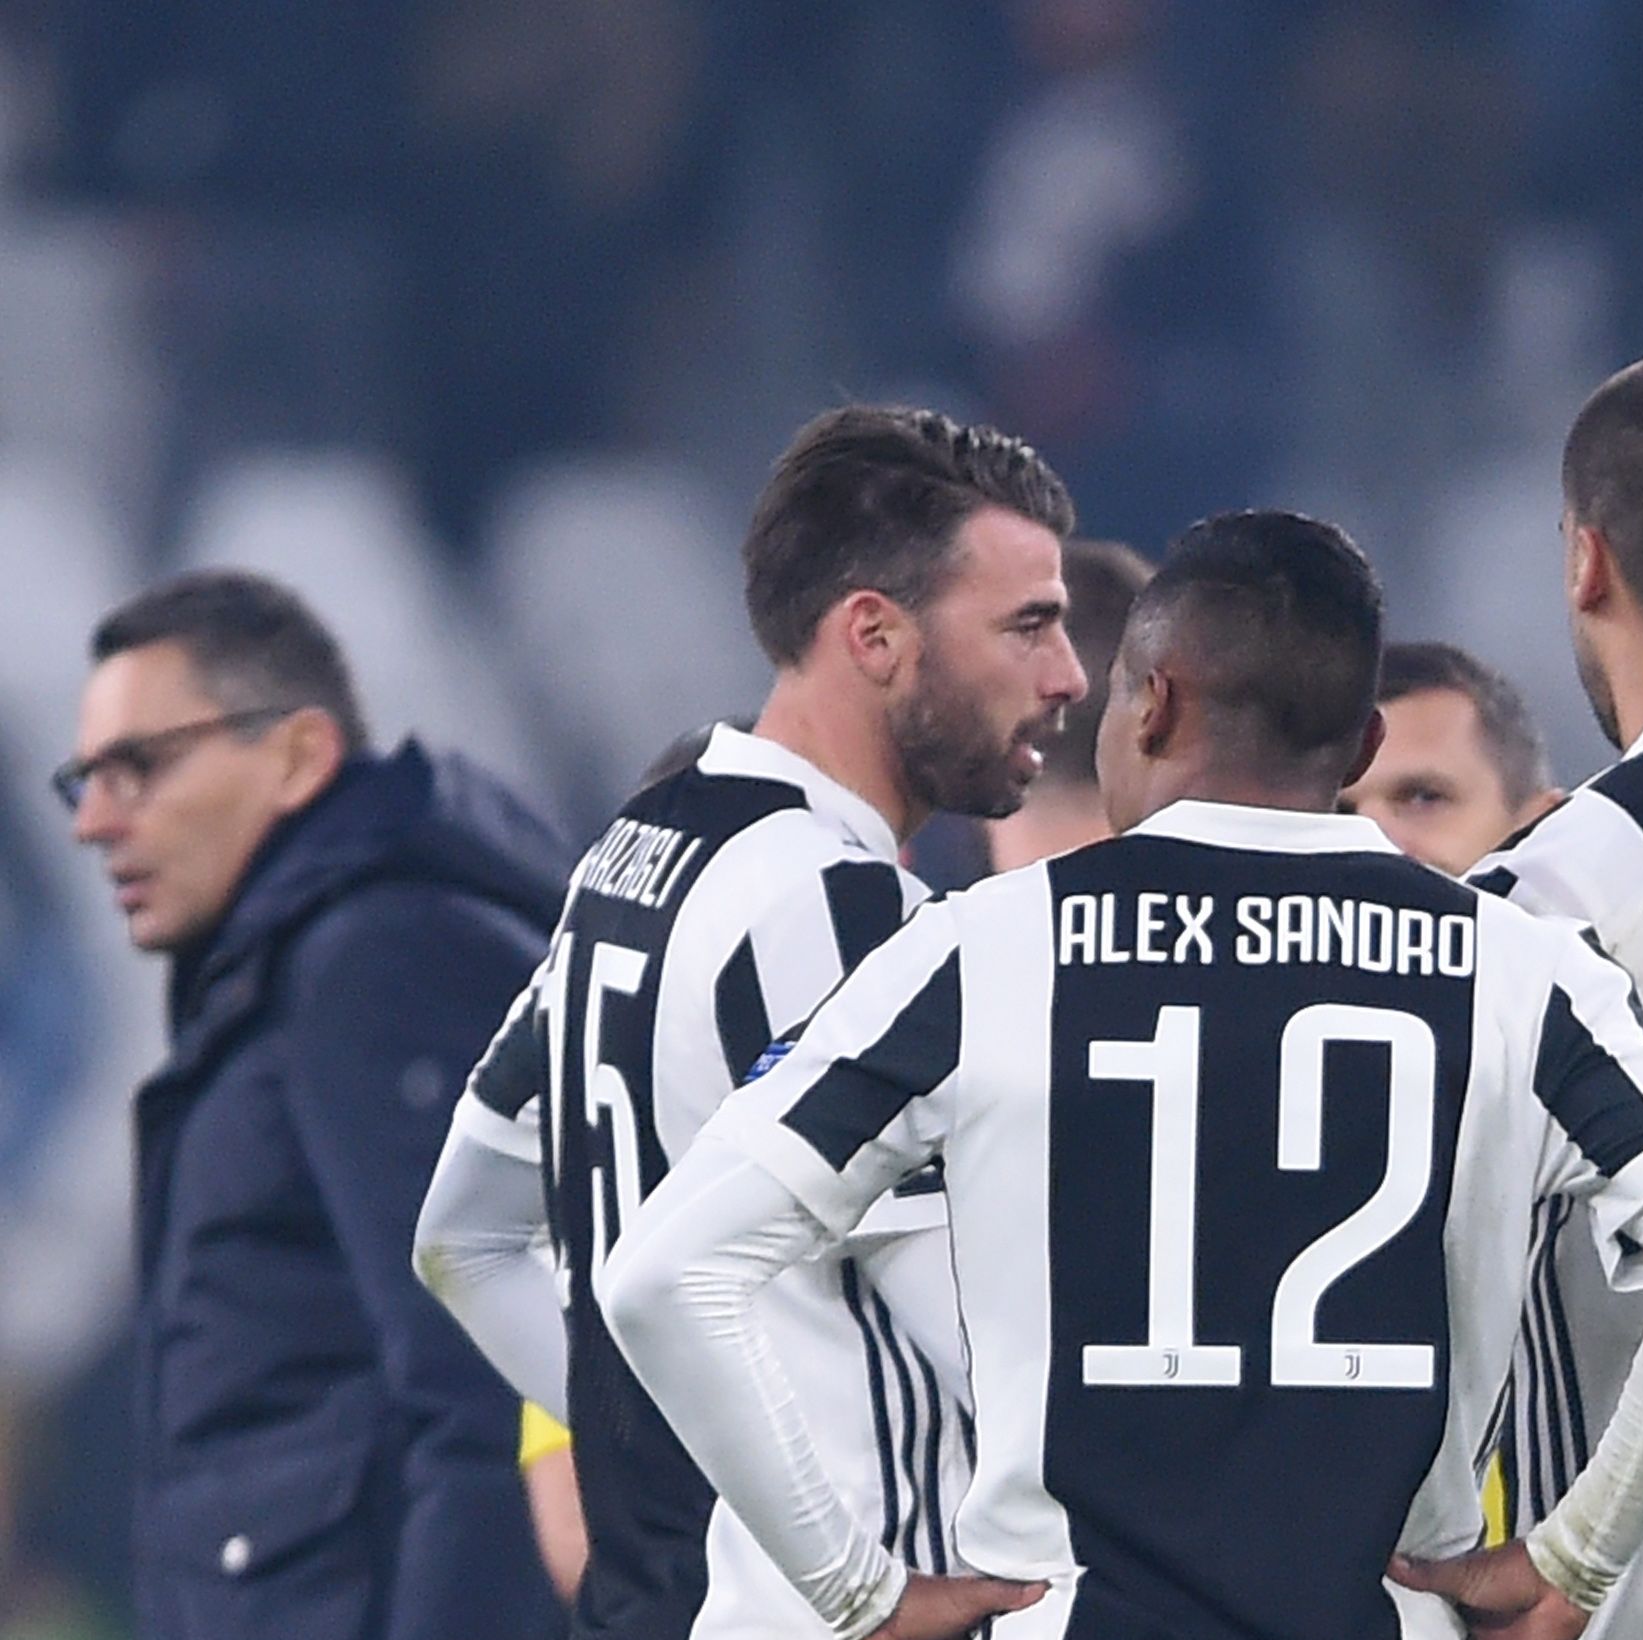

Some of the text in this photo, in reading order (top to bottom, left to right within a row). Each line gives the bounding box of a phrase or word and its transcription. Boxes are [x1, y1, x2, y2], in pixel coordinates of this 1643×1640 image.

[536, 930, 649, 1310] 15
[1059, 893, 1475, 978] ALEX SANDRO
[1082, 1003, 1437, 1388] 12
